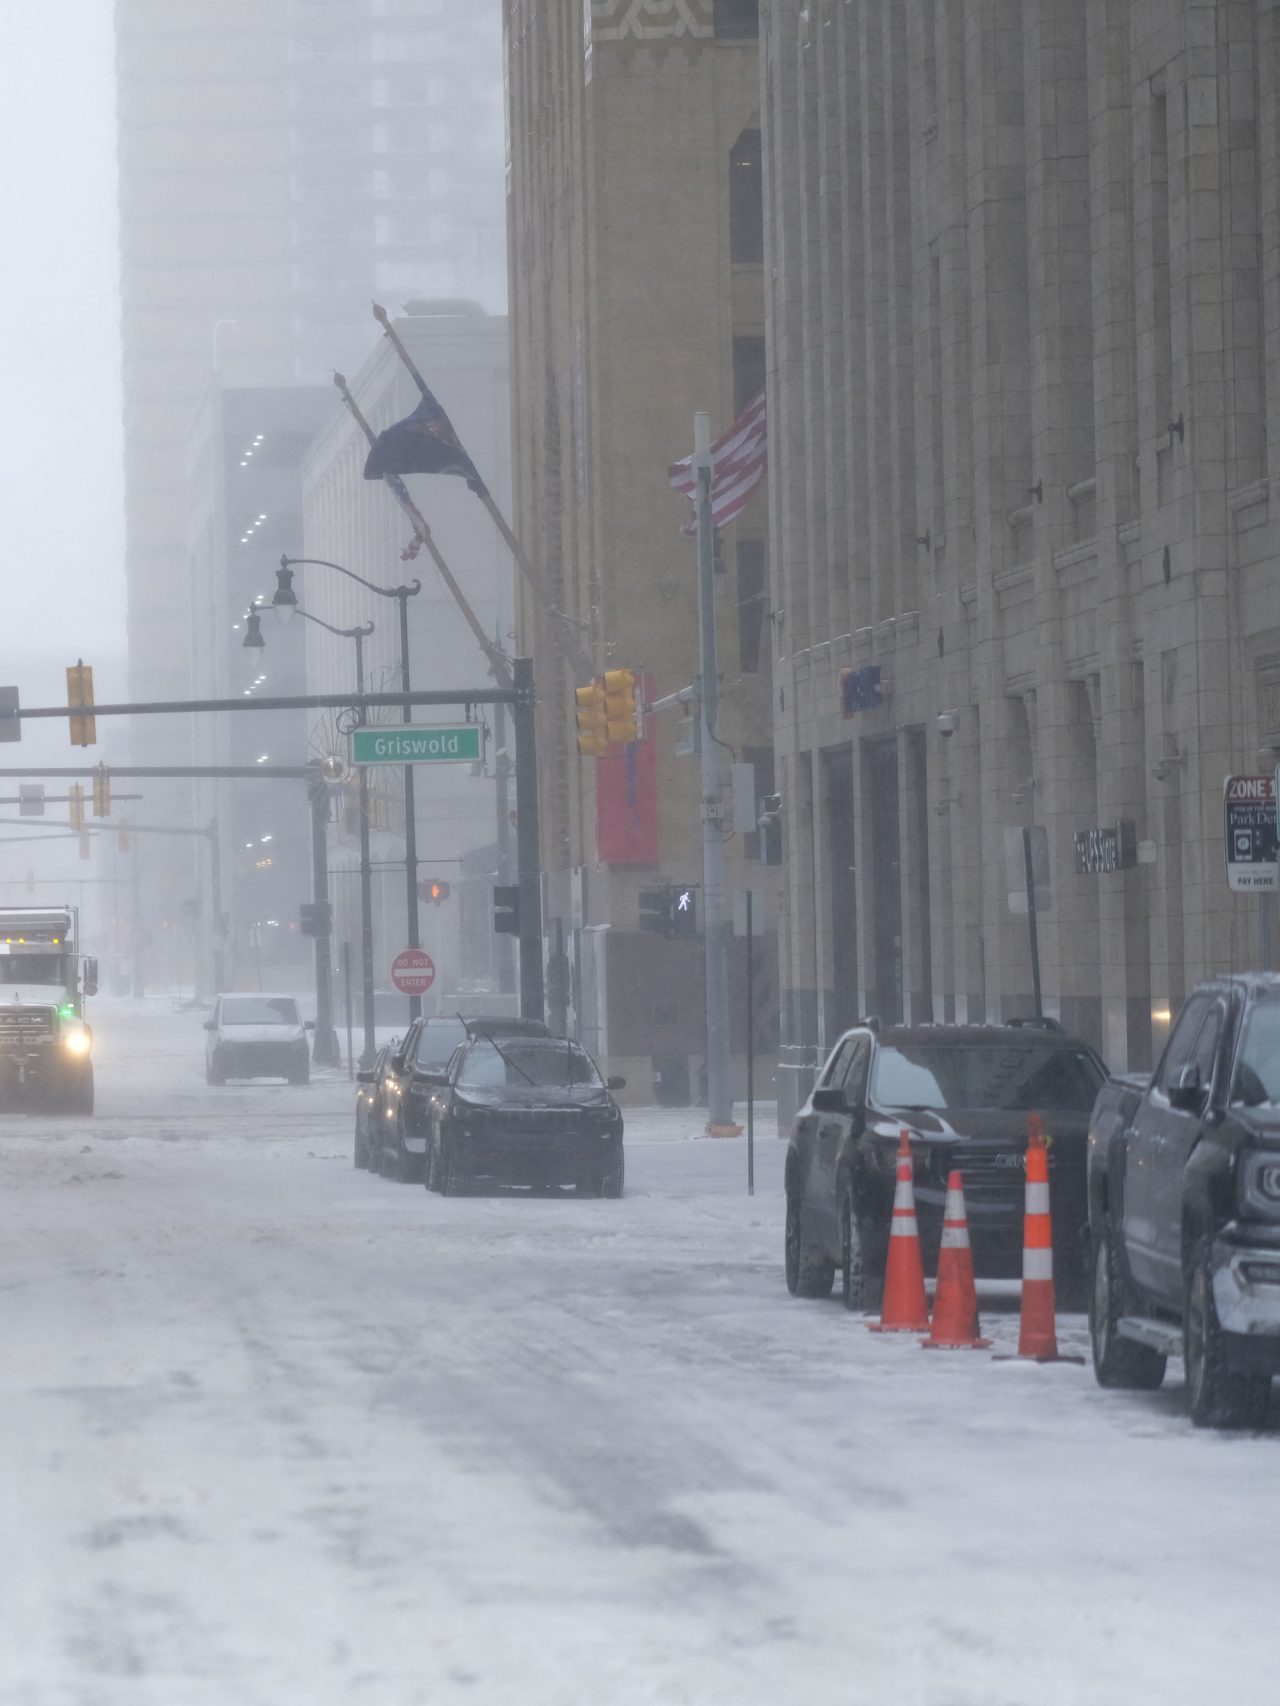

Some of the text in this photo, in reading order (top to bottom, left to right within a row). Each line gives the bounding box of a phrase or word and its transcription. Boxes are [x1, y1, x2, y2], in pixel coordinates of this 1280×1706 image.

[375, 735, 458, 755] Griswold
[1229, 780, 1277, 798] ZONE 1
[1237, 877, 1273, 885] PAY HERE
[398, 959, 429, 967] DO NOT
[400, 978, 426, 987] ENTER
